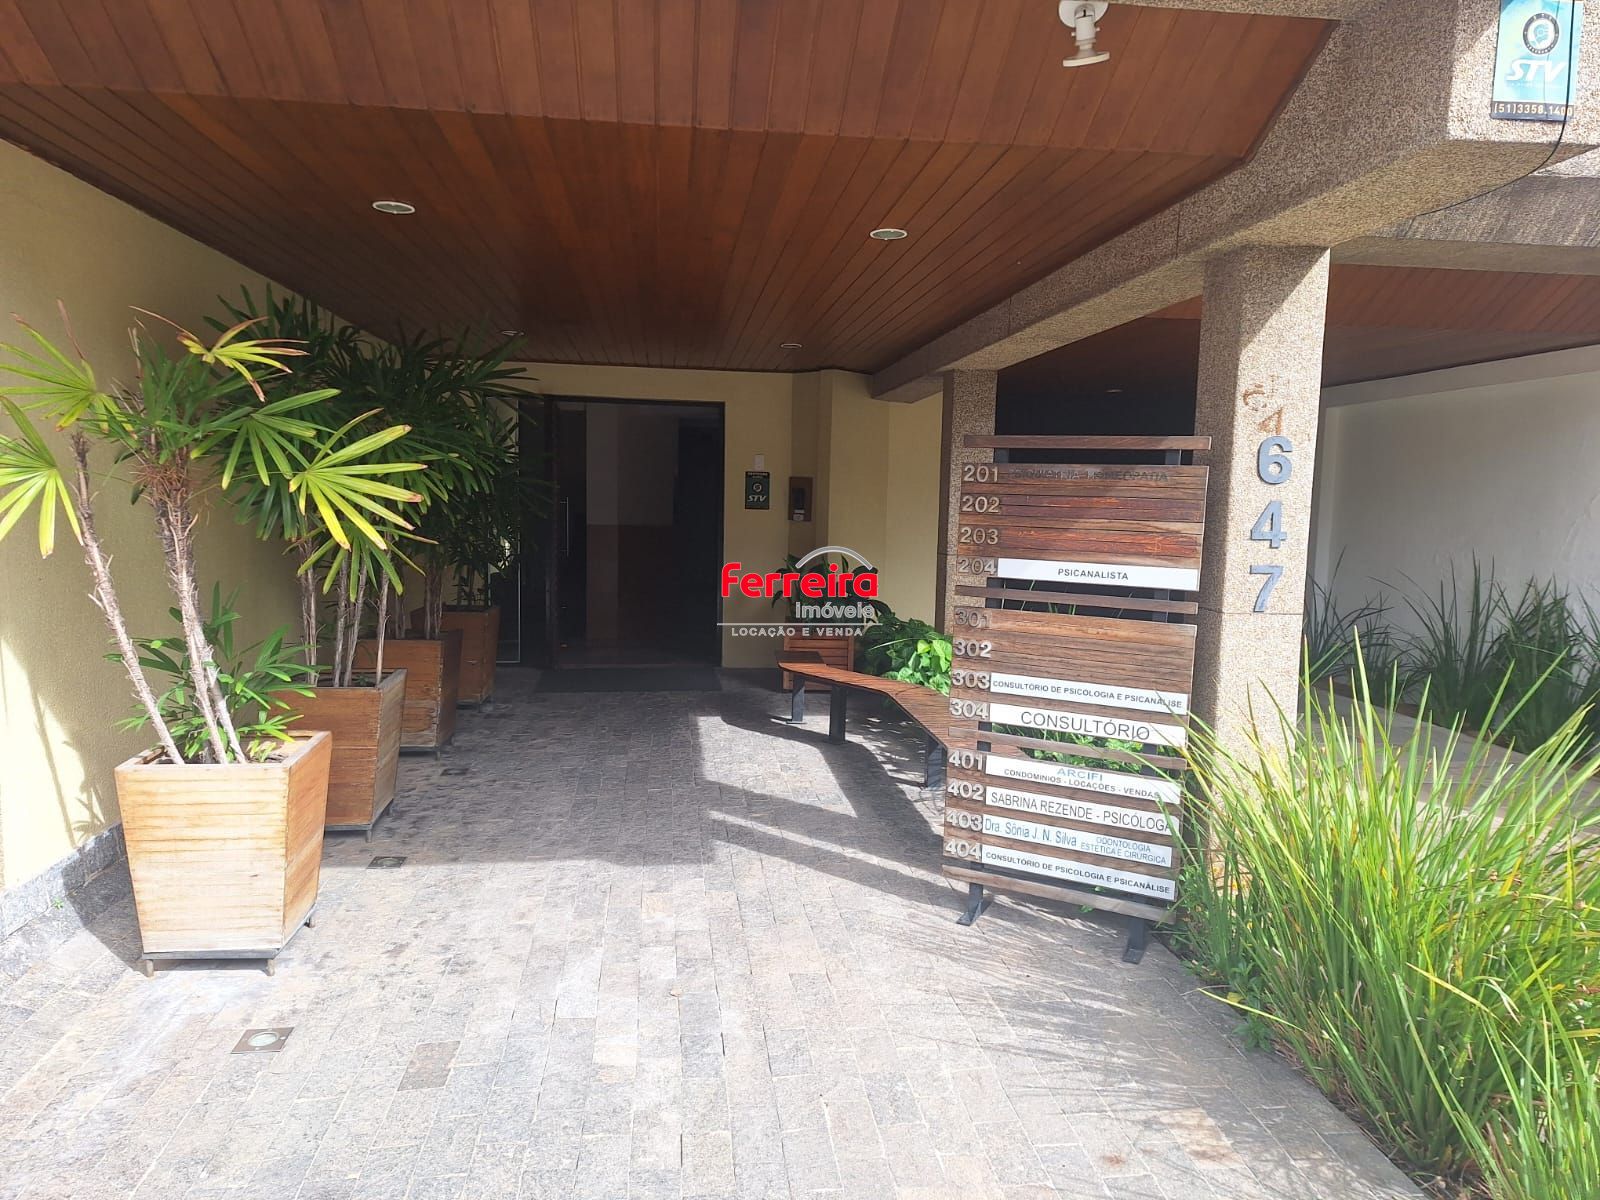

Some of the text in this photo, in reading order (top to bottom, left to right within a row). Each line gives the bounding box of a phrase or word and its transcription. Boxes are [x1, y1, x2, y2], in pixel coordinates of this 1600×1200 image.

[1506, 59, 1567, 81] STV
[964, 465, 999, 483] 201
[962, 495, 1001, 513] 202
[1249, 436, 1293, 613] 647
[960, 527, 999, 545] 203
[958, 557, 1129, 581] 204 PSICANALISTA
[954, 608, 992, 629] 301
[954, 640, 992, 658] 302
[952, 671, 990, 690] 303
[993, 680, 1049, 692] CONSULTÓRIO
[1051, 686, 1062, 694] DE
[1064, 688, 1115, 700] PSICOLOGIA
[1124, 694, 1182, 708] PSICANÁLISE
[950, 701, 1150, 741] 304 CONSULTÓRIO
[948, 752, 984, 771] 401
[1068, 779, 1116, 792] LOCAÇÕES
[1124, 787, 1159, 799] VENDAS
[1056, 768, 1103, 782] ARCIFI
[947, 782, 984, 801] 402
[991, 792, 1038, 811] SABRINA
[1040, 800, 1093, 820] REZENDE
[946, 812, 1078, 847] 403 Dra. Sônia J. N. Silva
[1096, 836, 1151, 853] ODONTOLOGIA
[1117, 847, 1122, 857] E
[944, 842, 1171, 894] 404 CONSULTÓRIO DE PSICOLOGIA E PSICANÁLISE
